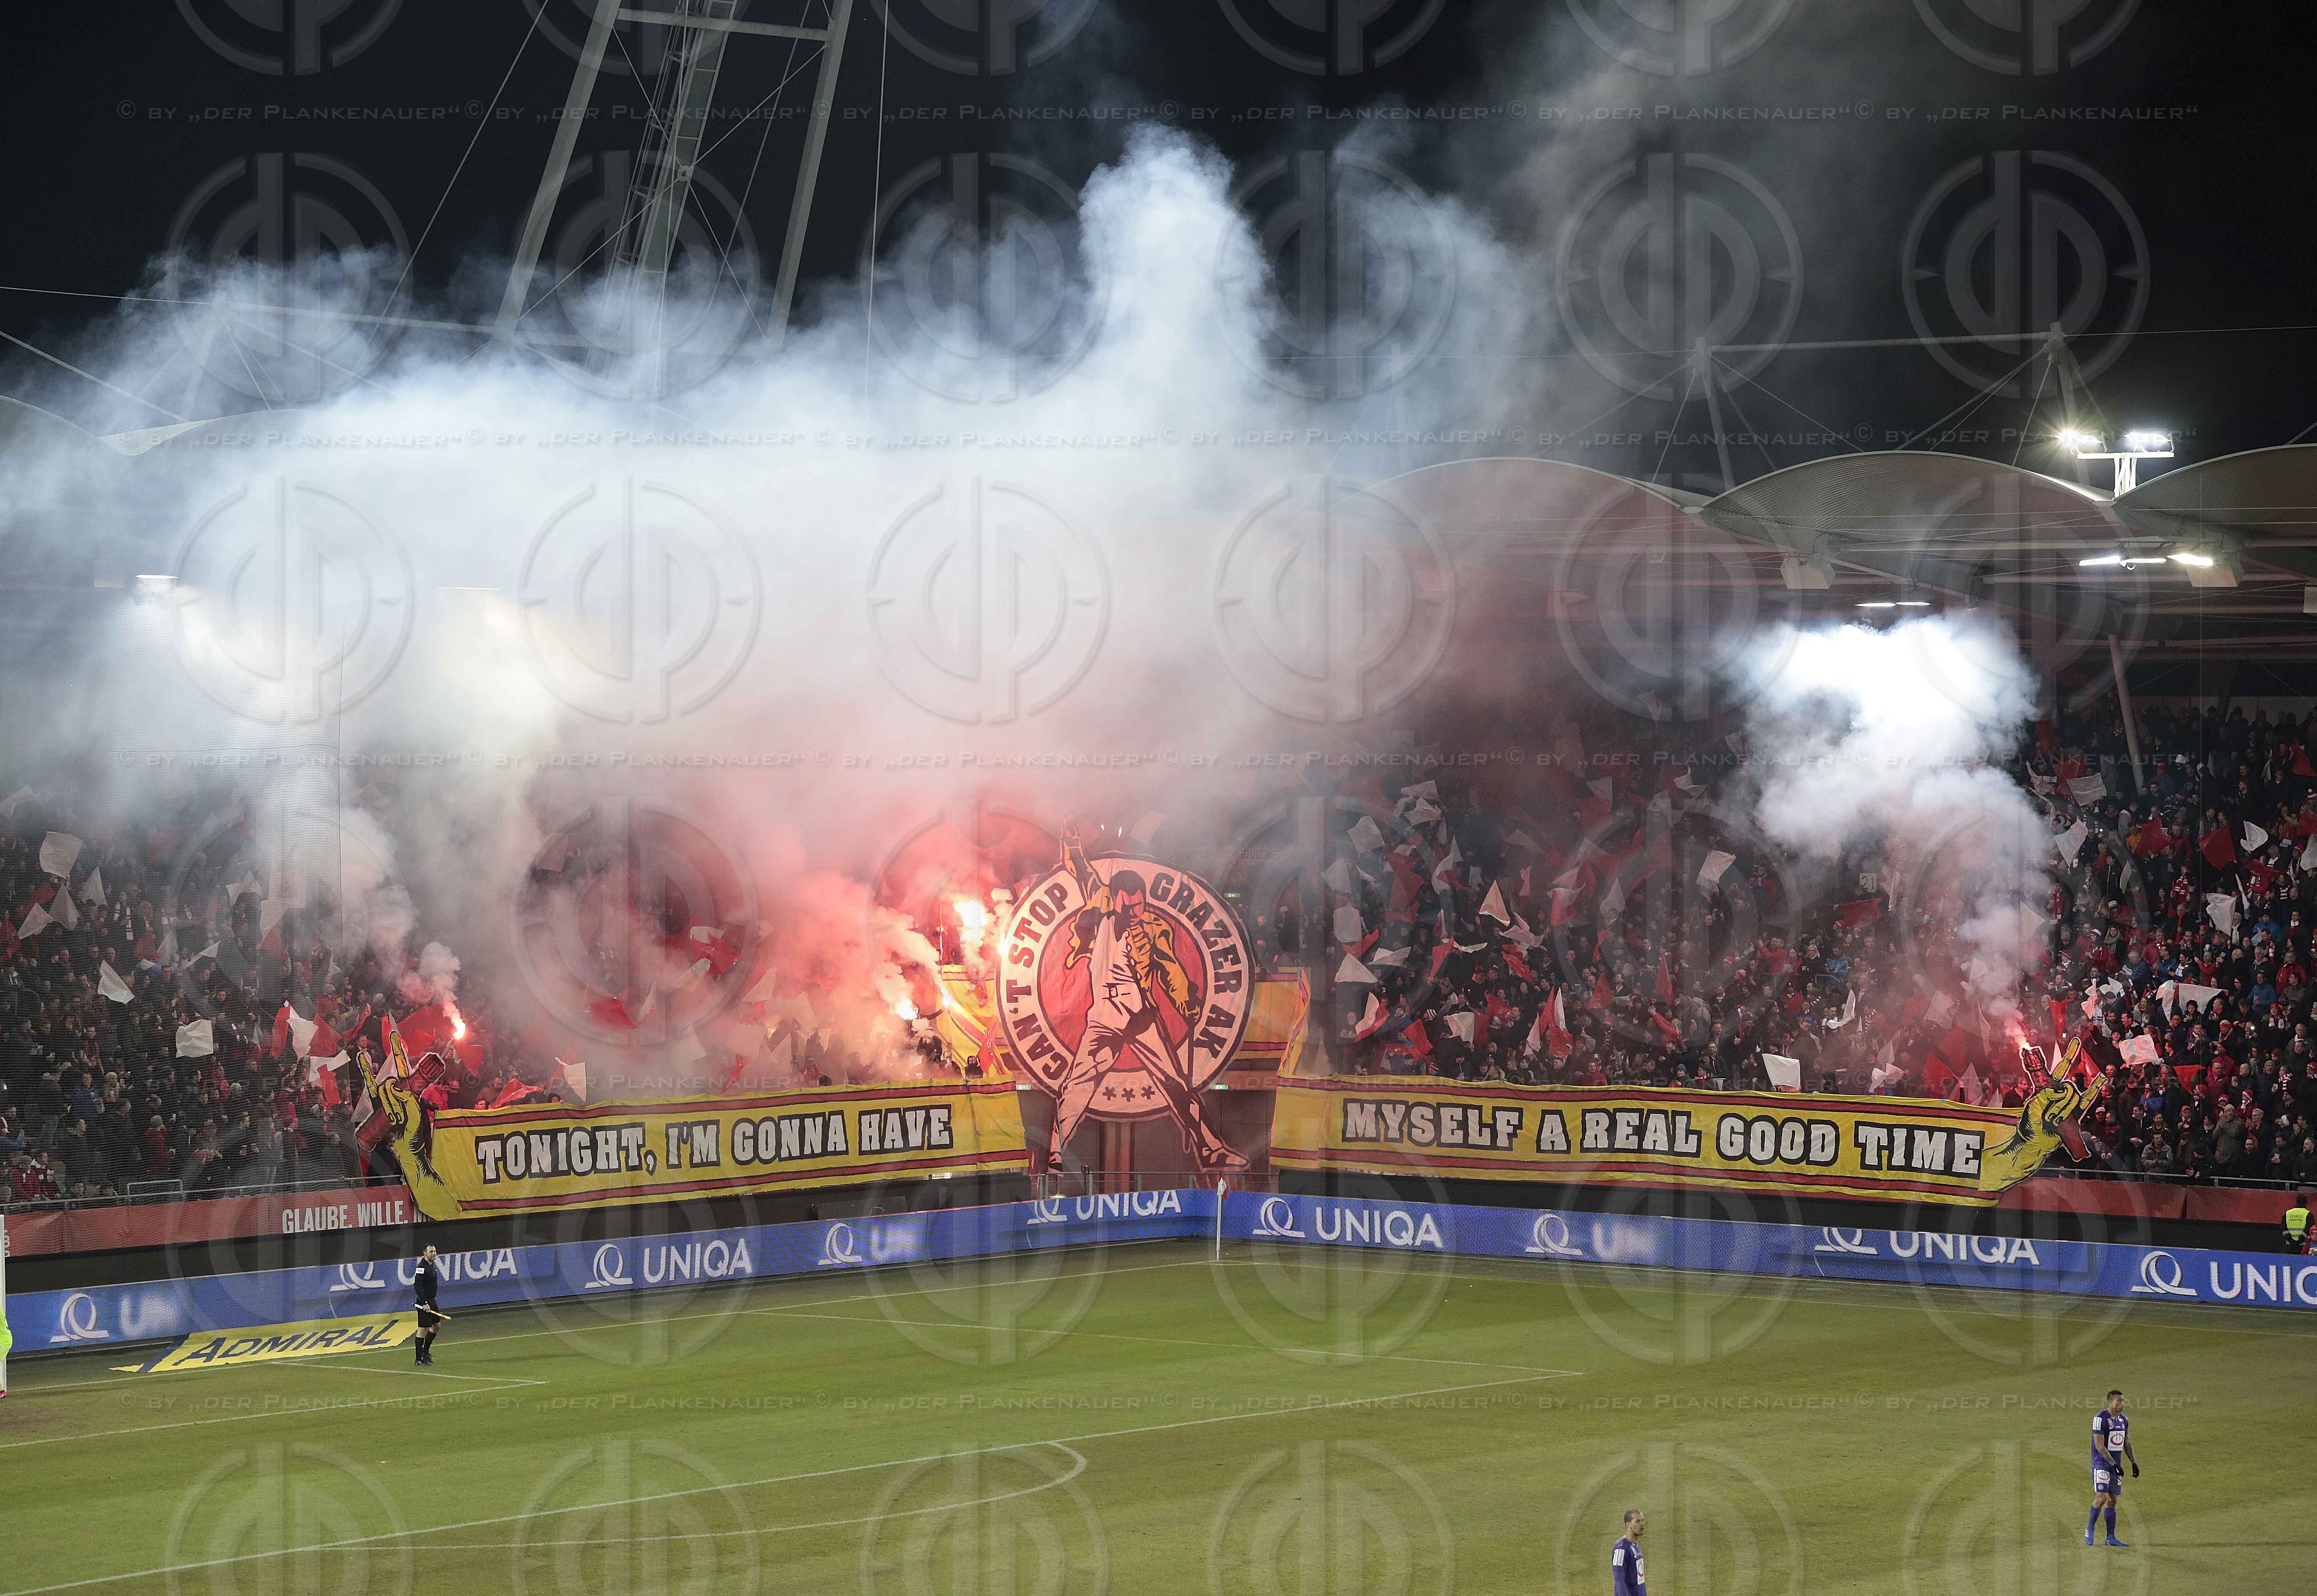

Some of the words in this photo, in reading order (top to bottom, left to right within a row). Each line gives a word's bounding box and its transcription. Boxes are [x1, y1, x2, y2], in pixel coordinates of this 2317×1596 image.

[1007, 882, 1069, 969] STOP
[1148, 871, 1243, 996] GRAZER
[1191, 1003, 1237, 1060] AK
[477, 1125, 655, 1182] TONIGHT,
[667, 1121, 718, 1166] I'M
[733, 1113, 848, 1163] GONNA
[859, 1107, 951, 1152] HAVE
[1344, 1101, 1521, 1149] MYSELF
[1539, 1112, 1569, 1152] A
[1581, 1110, 1700, 1154] REAL
[1717, 1115, 1837, 1163] GOOD
[1856, 1124, 1983, 1176] TIME
[1316, 1207, 1444, 1248] UNIQA
[1890, 1230, 2041, 1266] UNIQA
[643, 1238, 753, 1283] UNIQA
[173, 1320, 399, 1366] ADMIRAL
